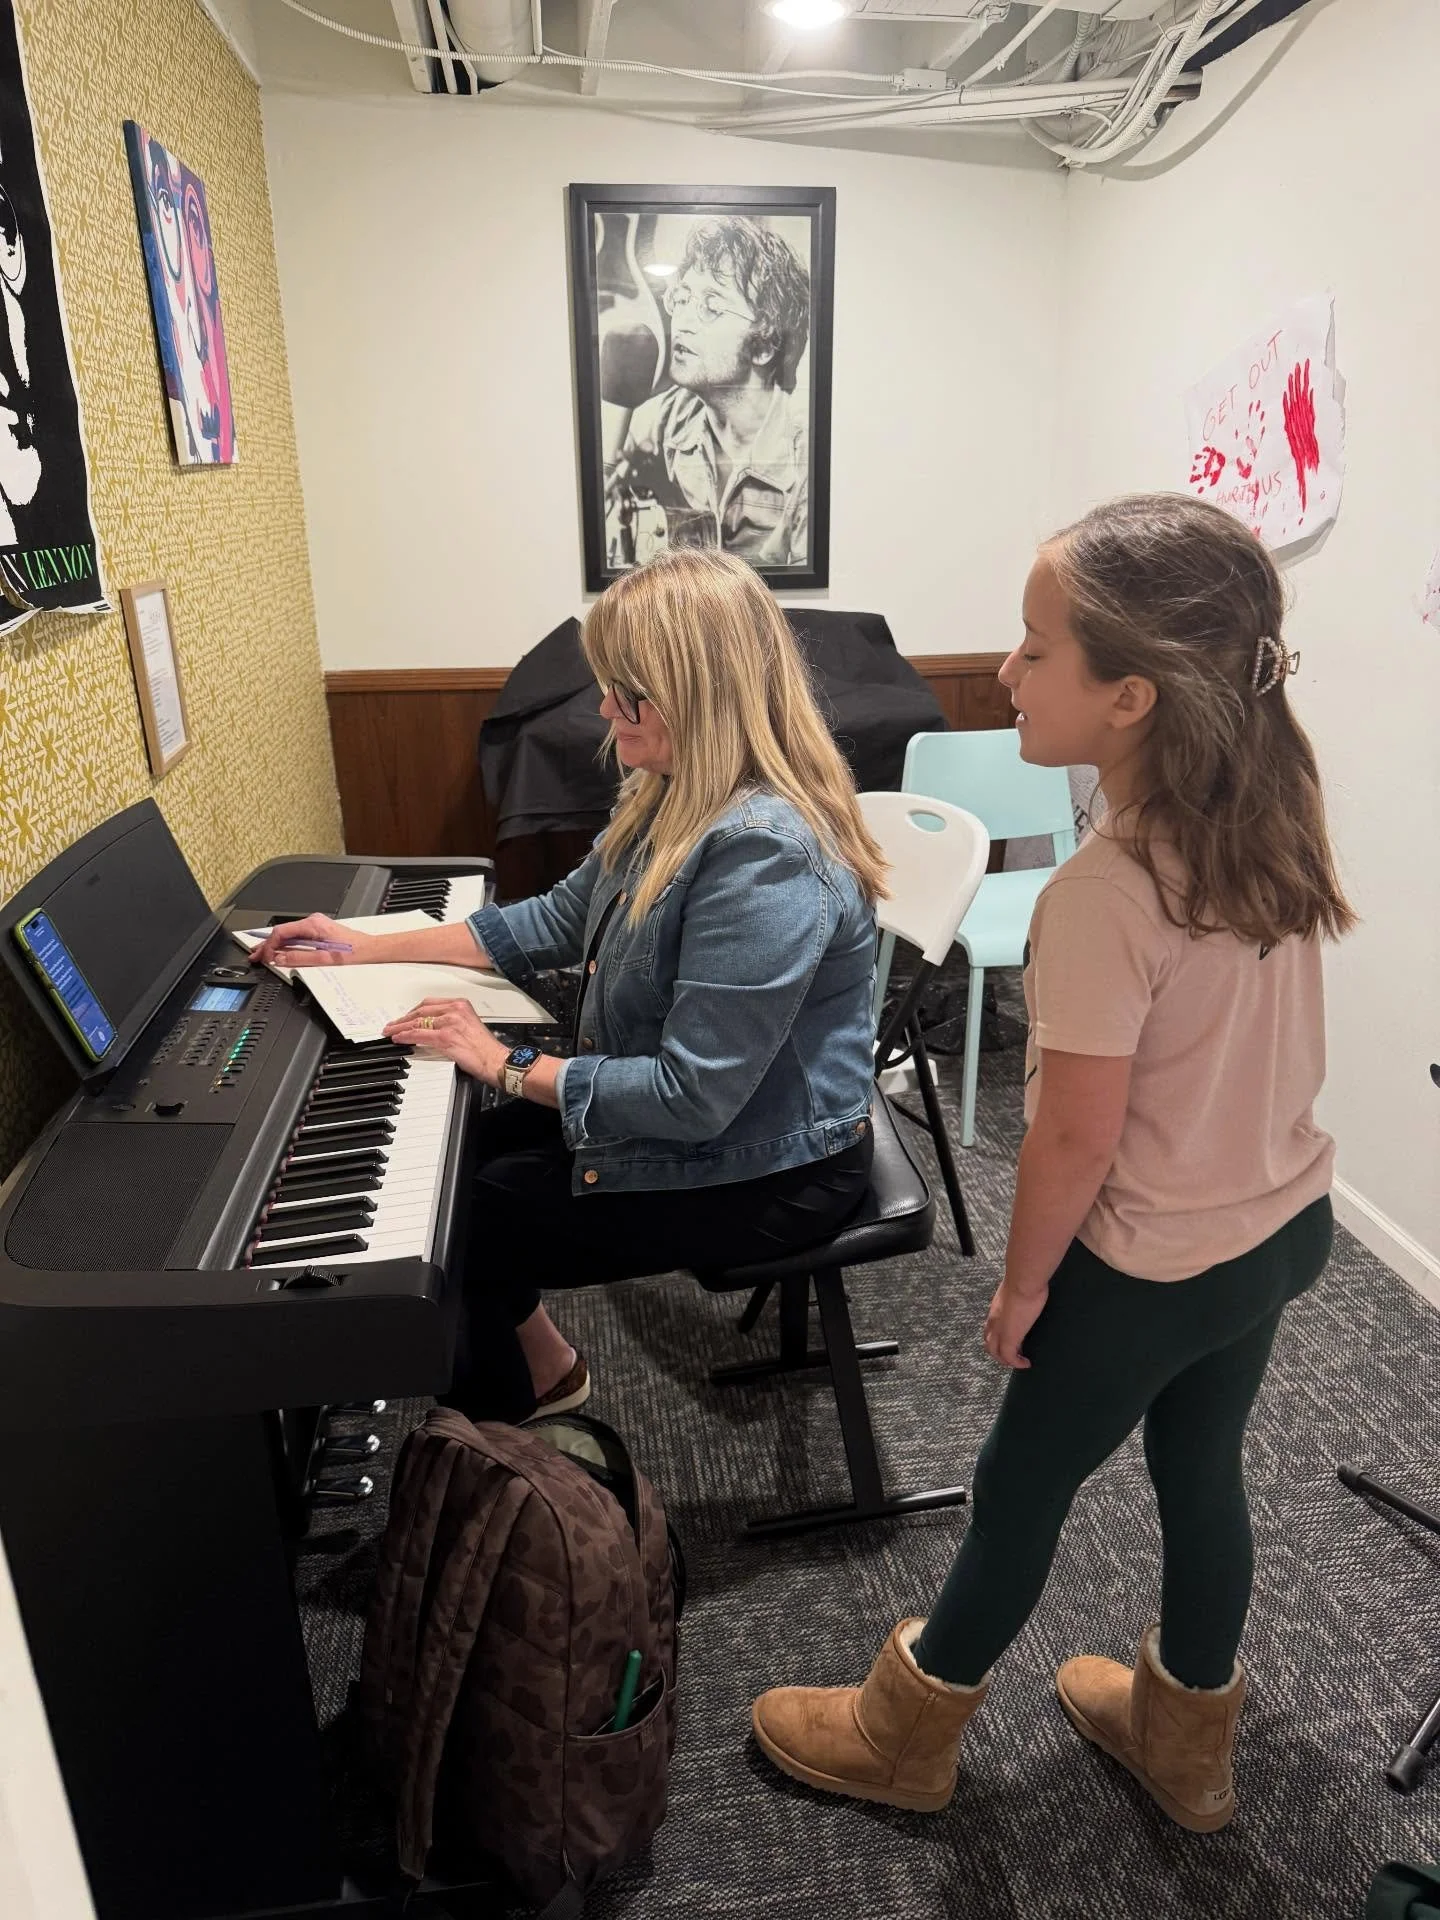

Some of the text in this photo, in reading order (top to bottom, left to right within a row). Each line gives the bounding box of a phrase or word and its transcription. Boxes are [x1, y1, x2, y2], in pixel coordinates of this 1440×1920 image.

[1203, 329, 1283, 442] GET OUT
[1261, 470, 1282, 498] US
[22, 543, 94, 590] LENNON
